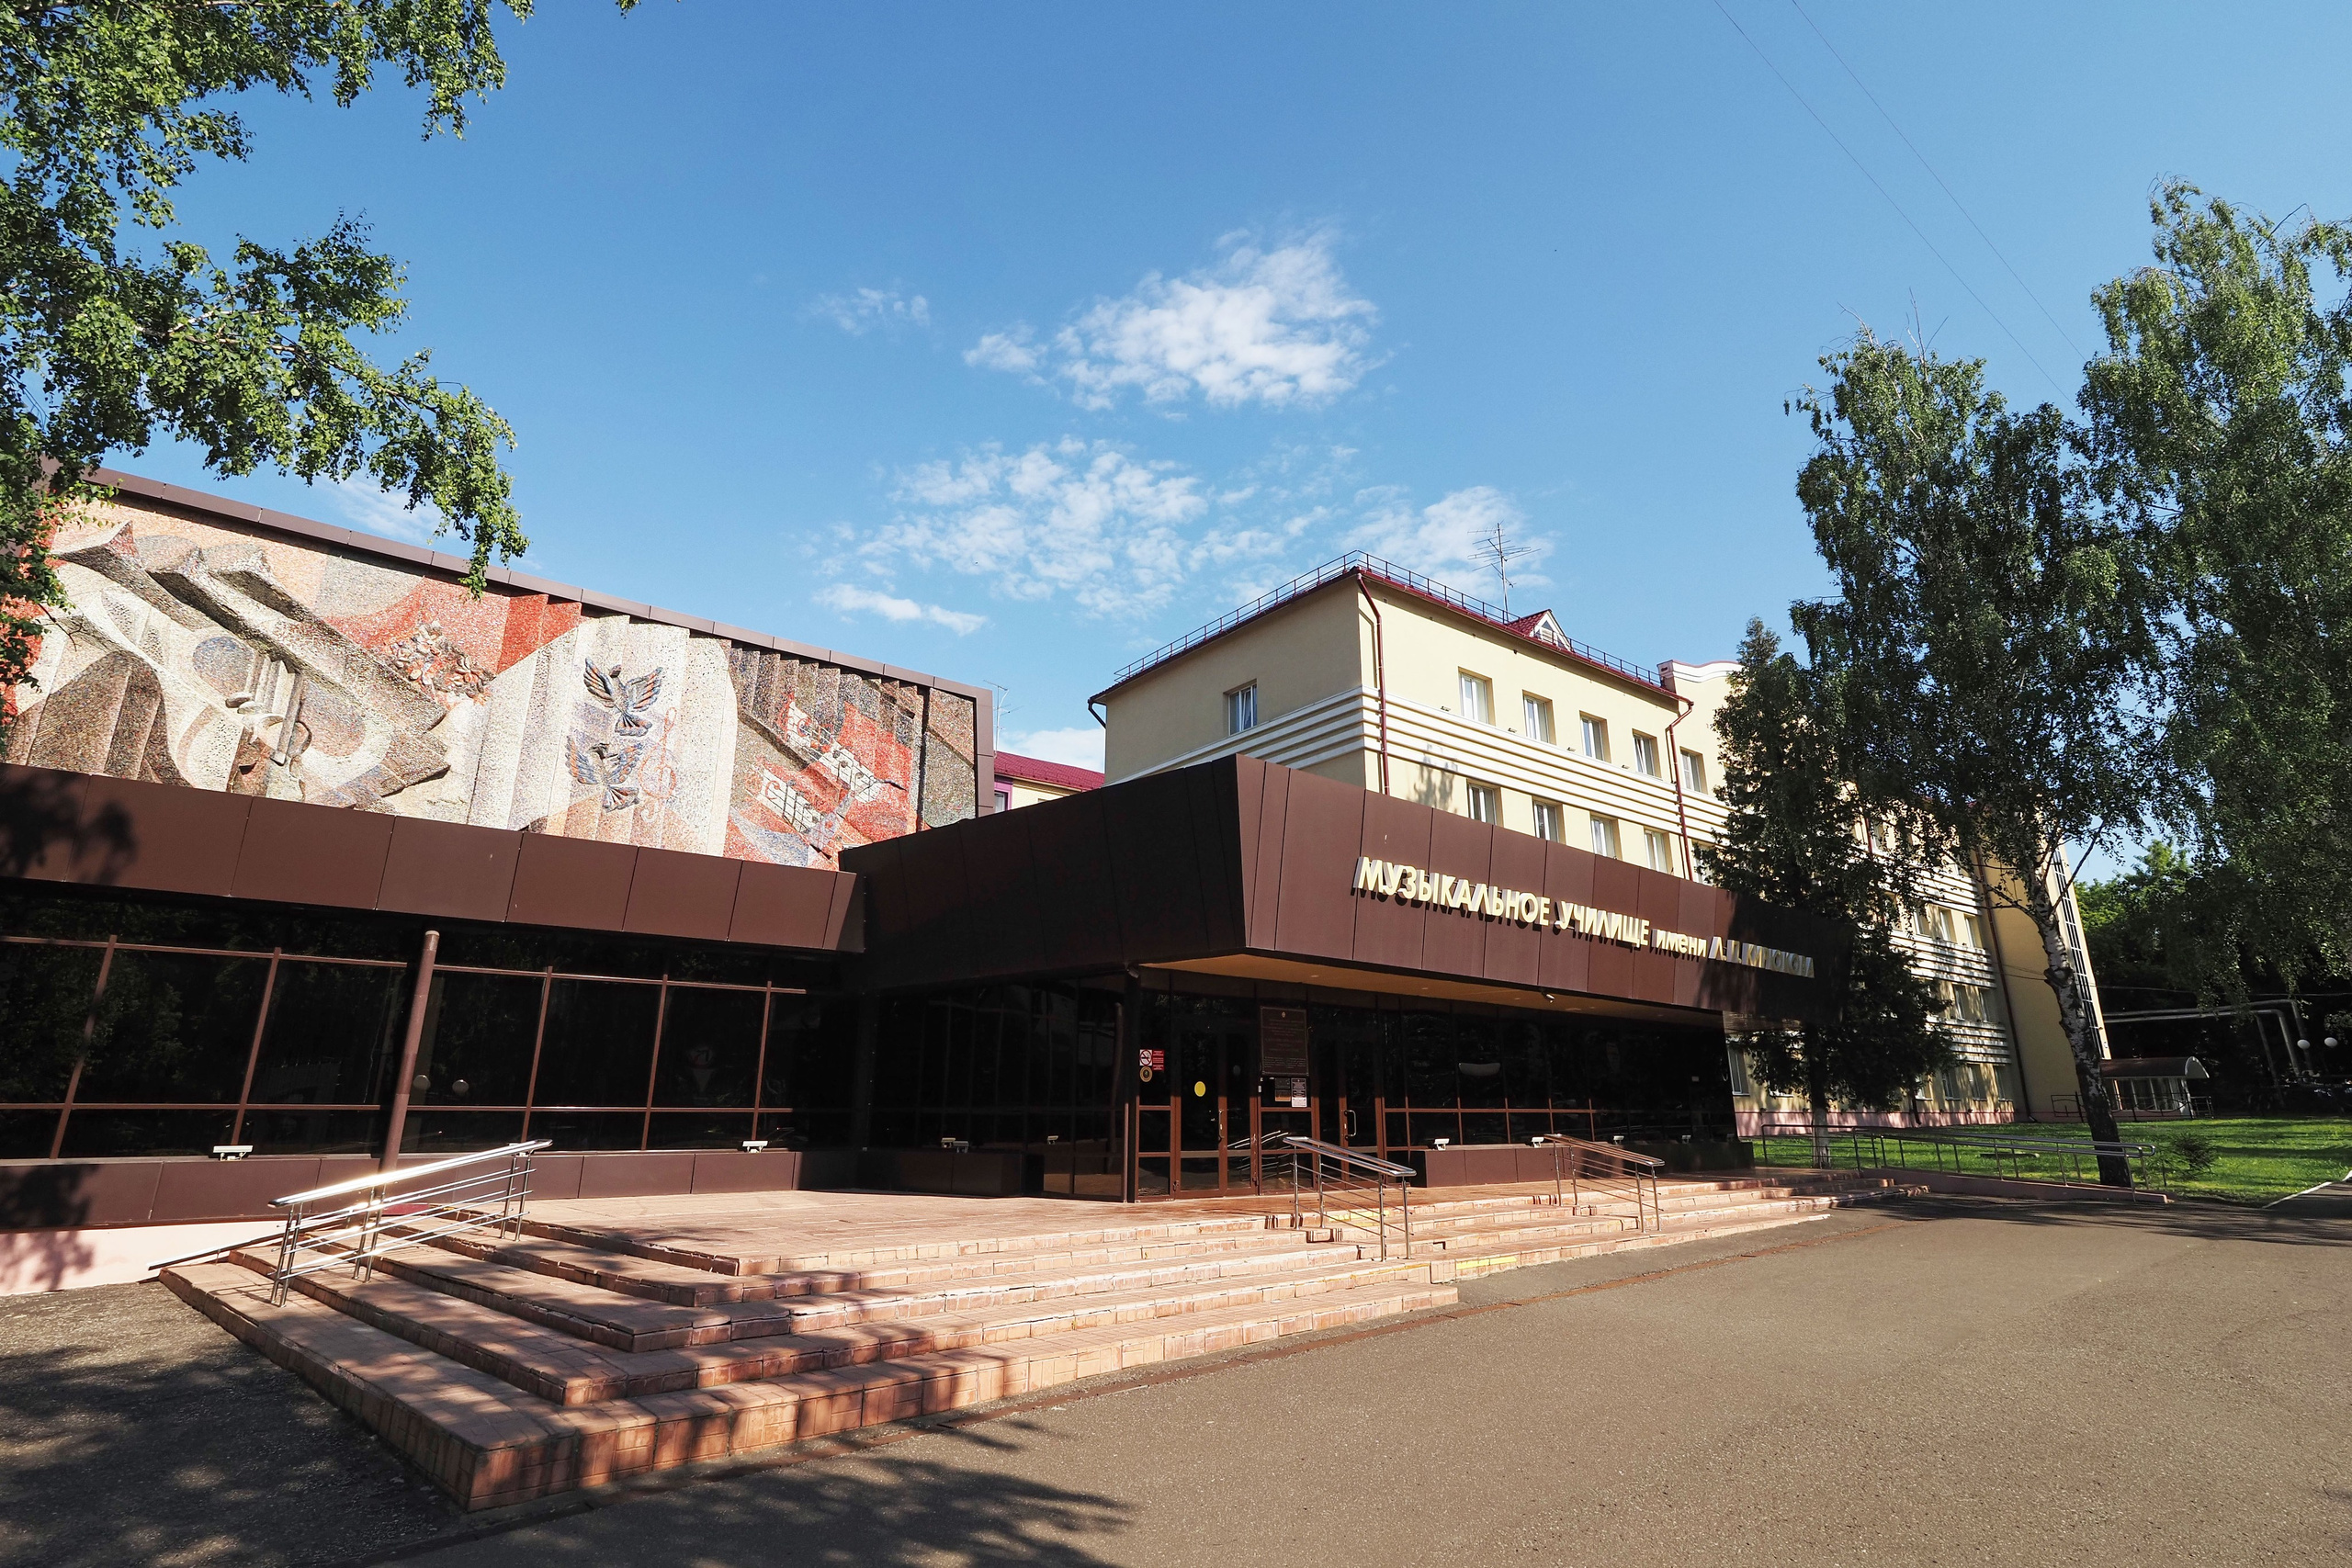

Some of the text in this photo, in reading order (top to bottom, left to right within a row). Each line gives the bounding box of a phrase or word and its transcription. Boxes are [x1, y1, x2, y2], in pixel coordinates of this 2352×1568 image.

[1352, 856, 1551, 927] МУЗЫКАЛЬНОЕ
[1555, 900, 1650, 948] УЧИЛИЩЕ
[1652, 929, 1707, 958] имени
